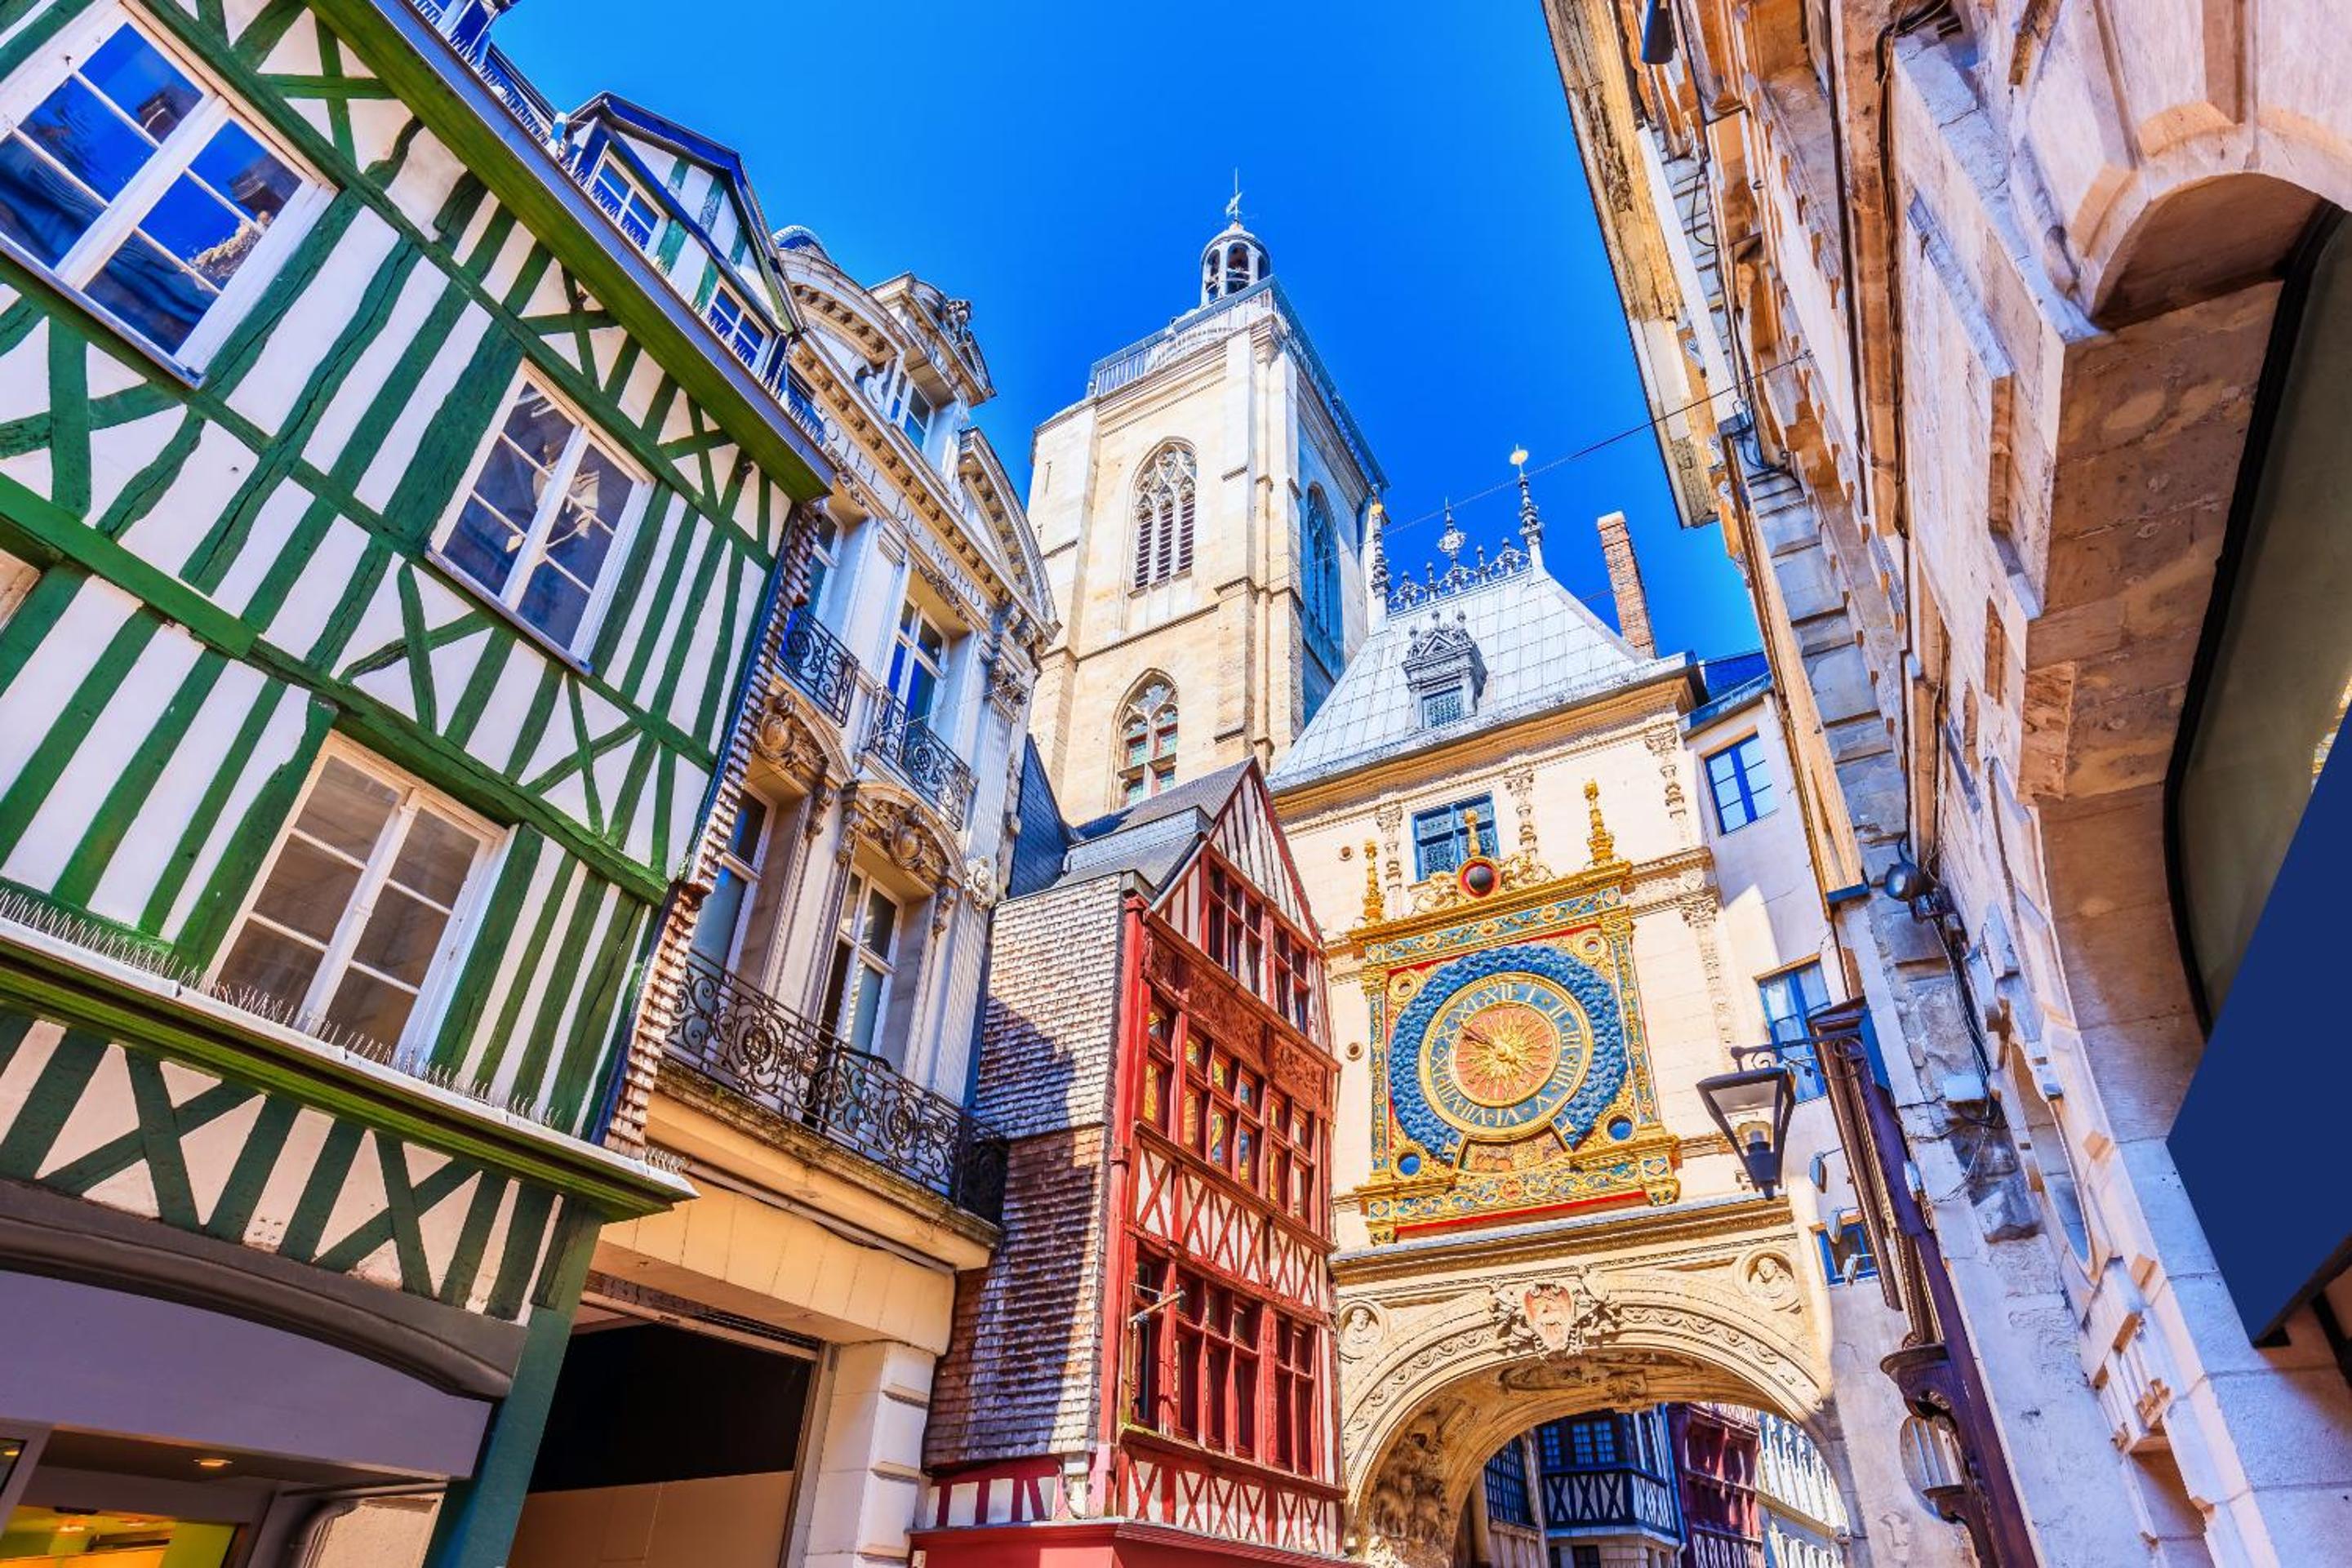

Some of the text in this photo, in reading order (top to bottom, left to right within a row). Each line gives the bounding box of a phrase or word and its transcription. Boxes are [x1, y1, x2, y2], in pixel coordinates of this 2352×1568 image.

[816, 406, 981, 606] OTEL DU NORD
[1484, 984, 1513, 1005] XII
[1526, 987, 1538, 1002] I
[1452, 995, 1478, 1020] XI
[1548, 1004, 1567, 1019] II
[1436, 1024, 1457, 1043] X
[1561, 1030, 1581, 1050] III
[1431, 1052, 1451, 1077] IX
[1551, 1061, 1579, 1088] IIII
[1436, 1079, 1461, 1115] VIII
[1536, 1095, 1554, 1113] V
[1461, 1102, 1487, 1126] VII
[1496, 1108, 1521, 1126] VI
